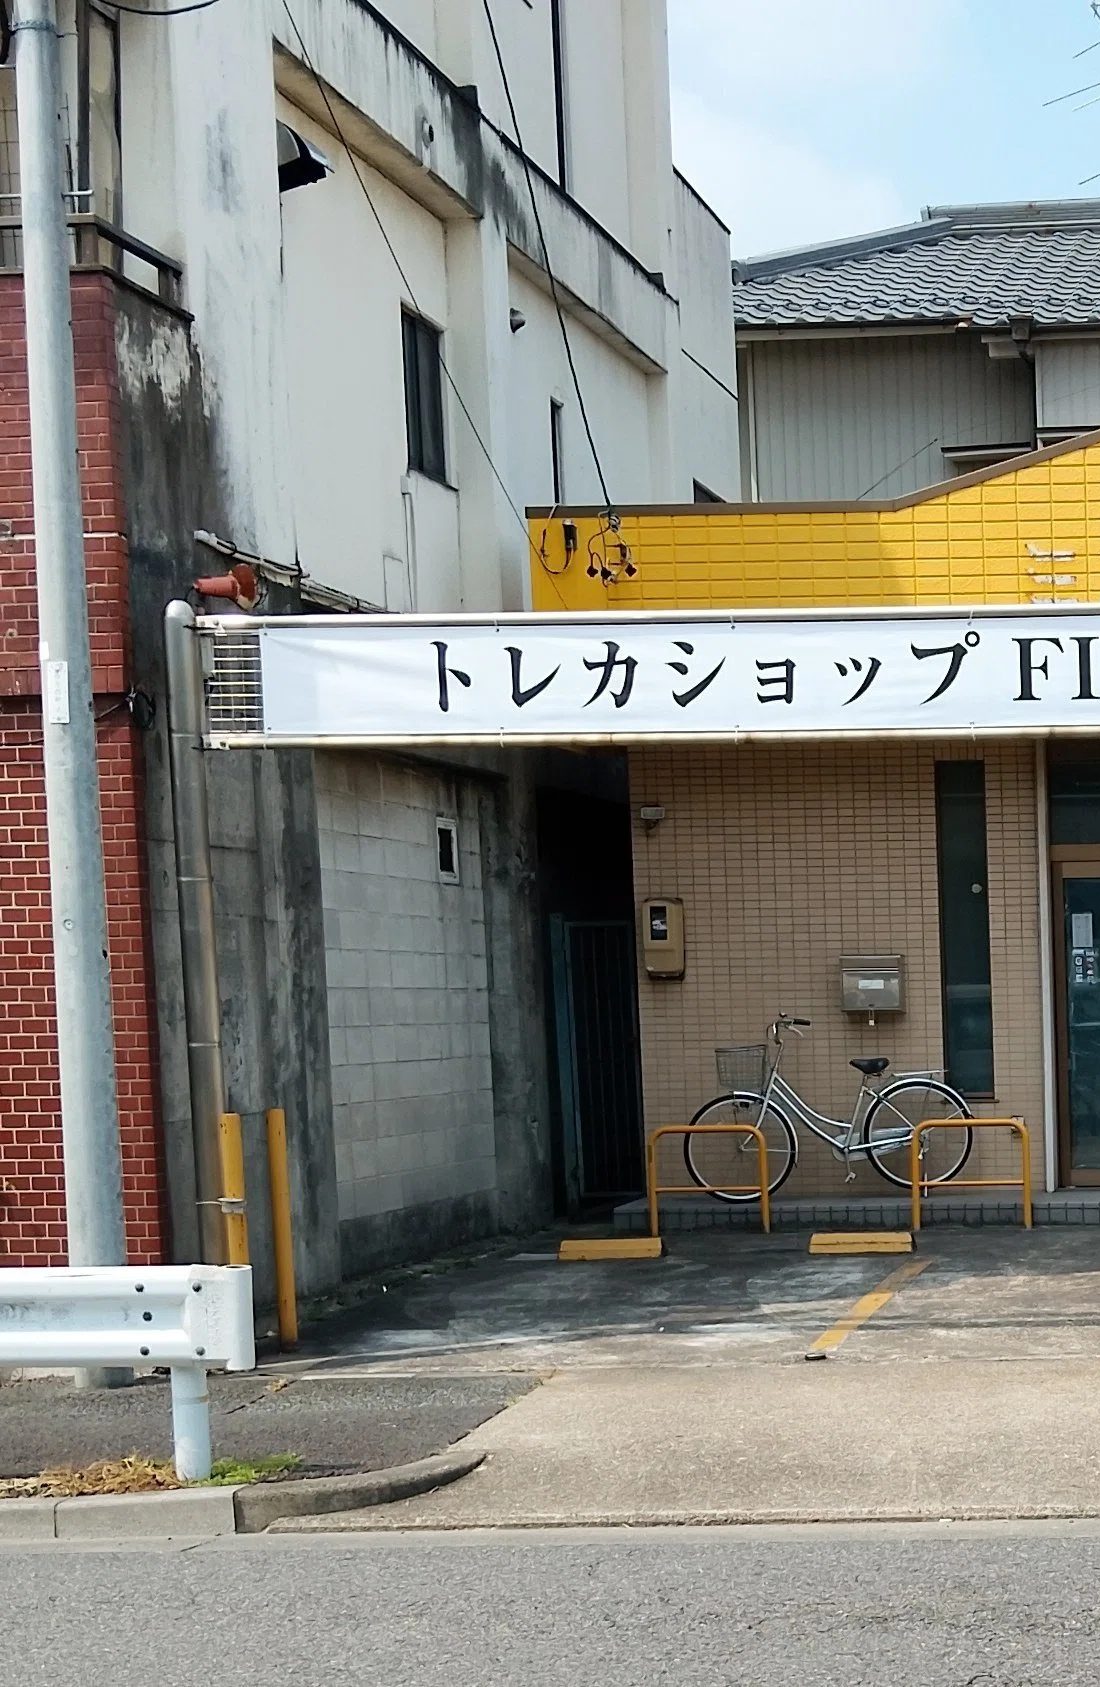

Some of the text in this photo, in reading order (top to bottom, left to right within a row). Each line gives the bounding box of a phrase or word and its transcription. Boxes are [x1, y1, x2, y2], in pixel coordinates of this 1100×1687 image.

[432, 631, 981, 712] トレカショップ
